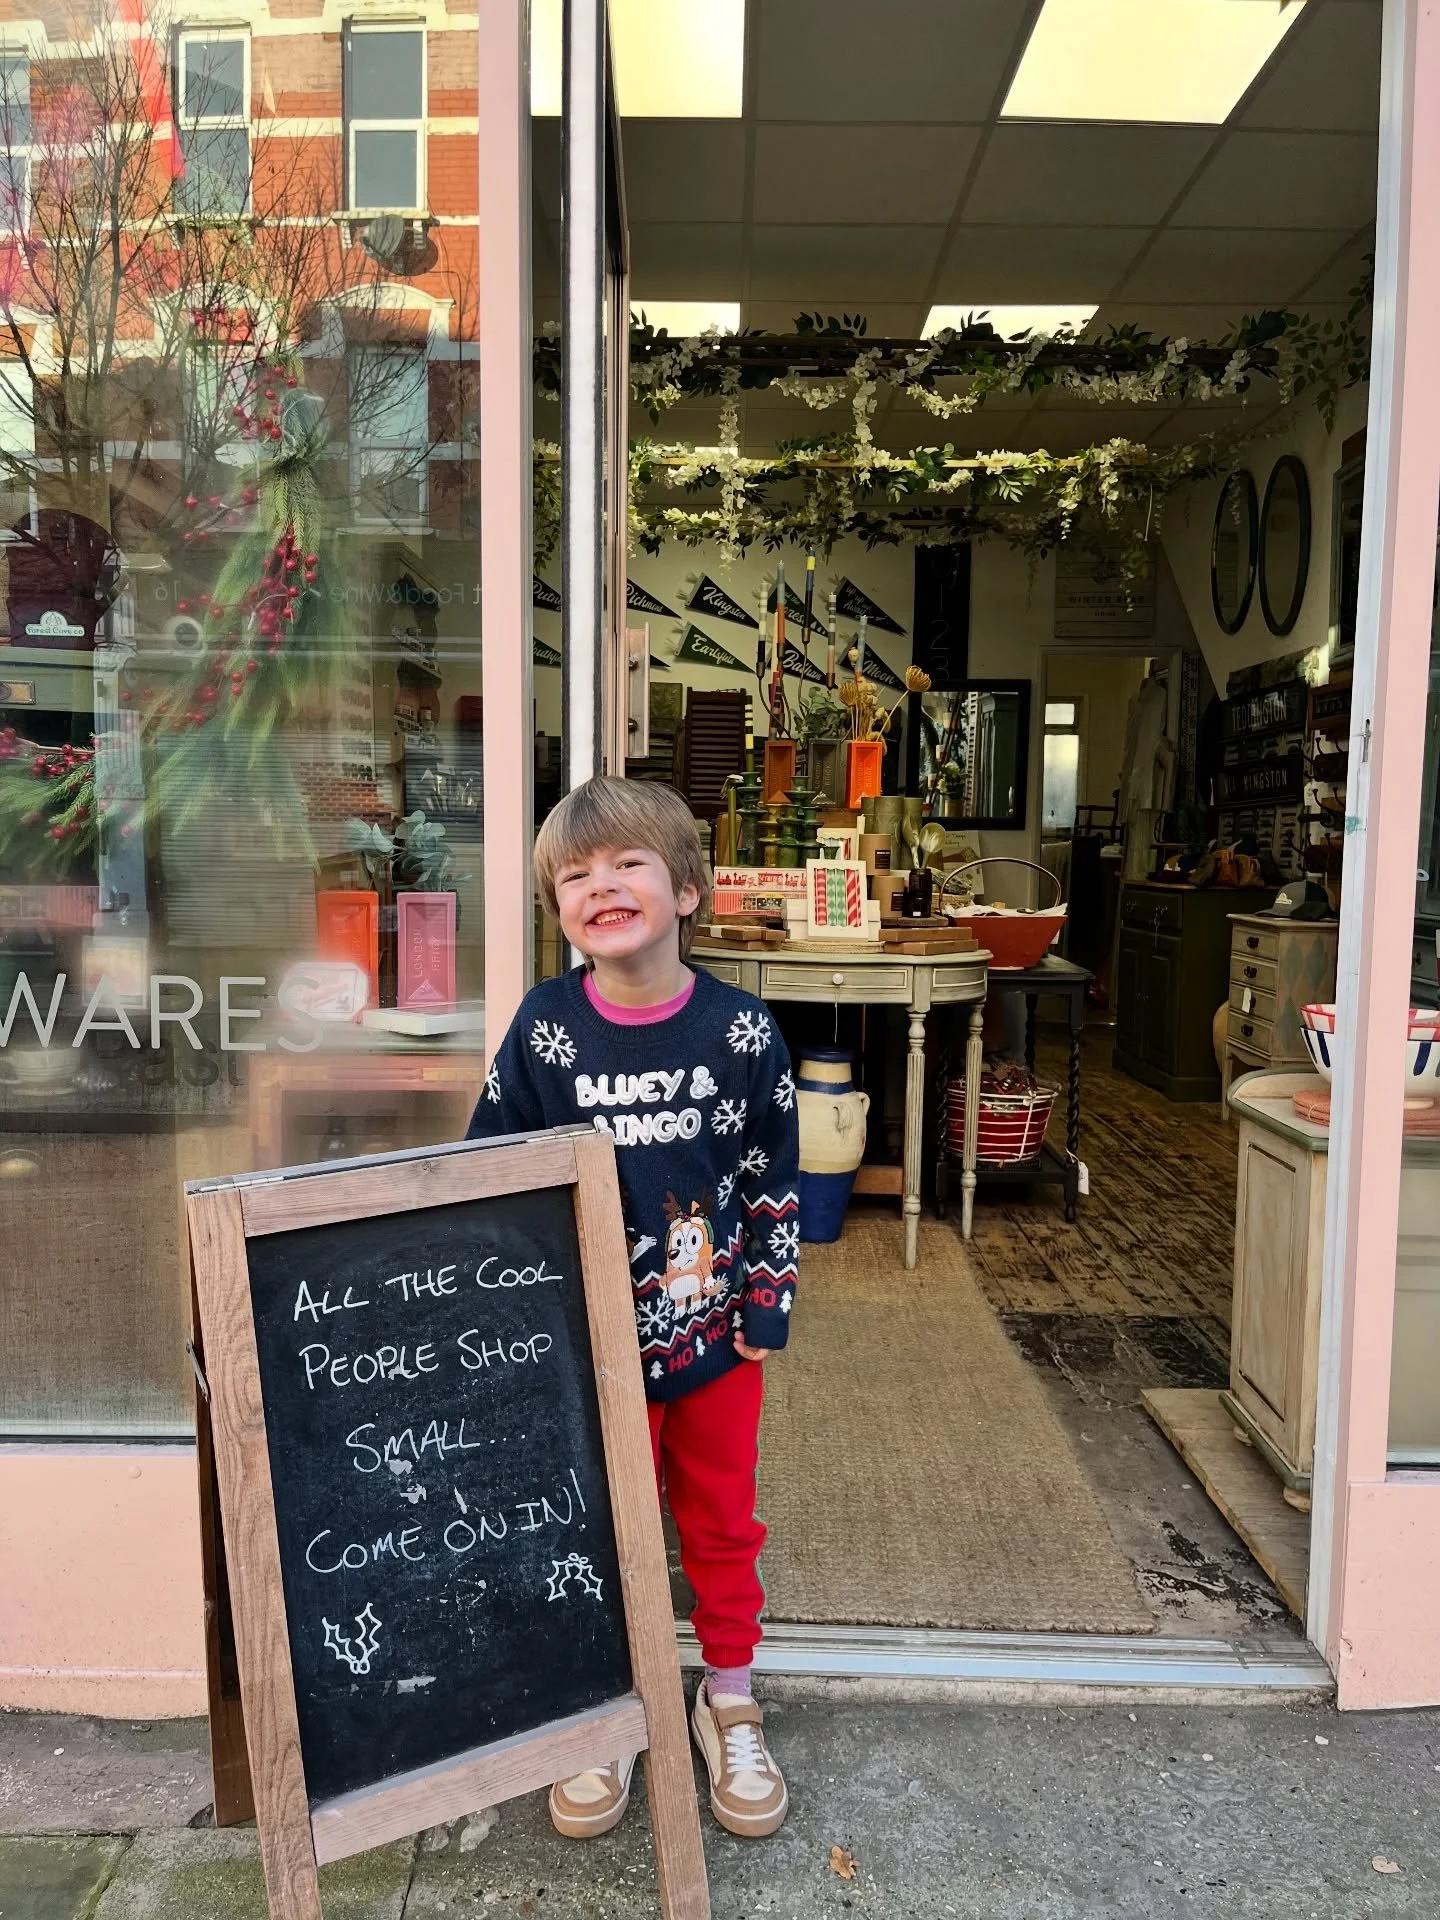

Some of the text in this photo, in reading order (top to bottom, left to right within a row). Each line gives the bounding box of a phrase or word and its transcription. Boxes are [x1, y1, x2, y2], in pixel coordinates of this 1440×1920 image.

[703, 586, 746, 620] Kingston
[863, 660, 895, 685] Moon
[1244, 768, 1287, 791] KINGSTON
[413, 929, 423, 977] LONDON
[0, 971, 323, 1053] WARES
[575, 1065, 718, 1107] BLUEY &
[294, 1257, 563, 1322] ALL THE COOL
[751, 1288, 776, 1308] HO
[299, 1329, 552, 1389] PEOPLE SHOP
[668, 1320, 728, 1373] HO HO
[306, 1525, 425, 1573] COME
[444, 1512, 507, 1552] ON
